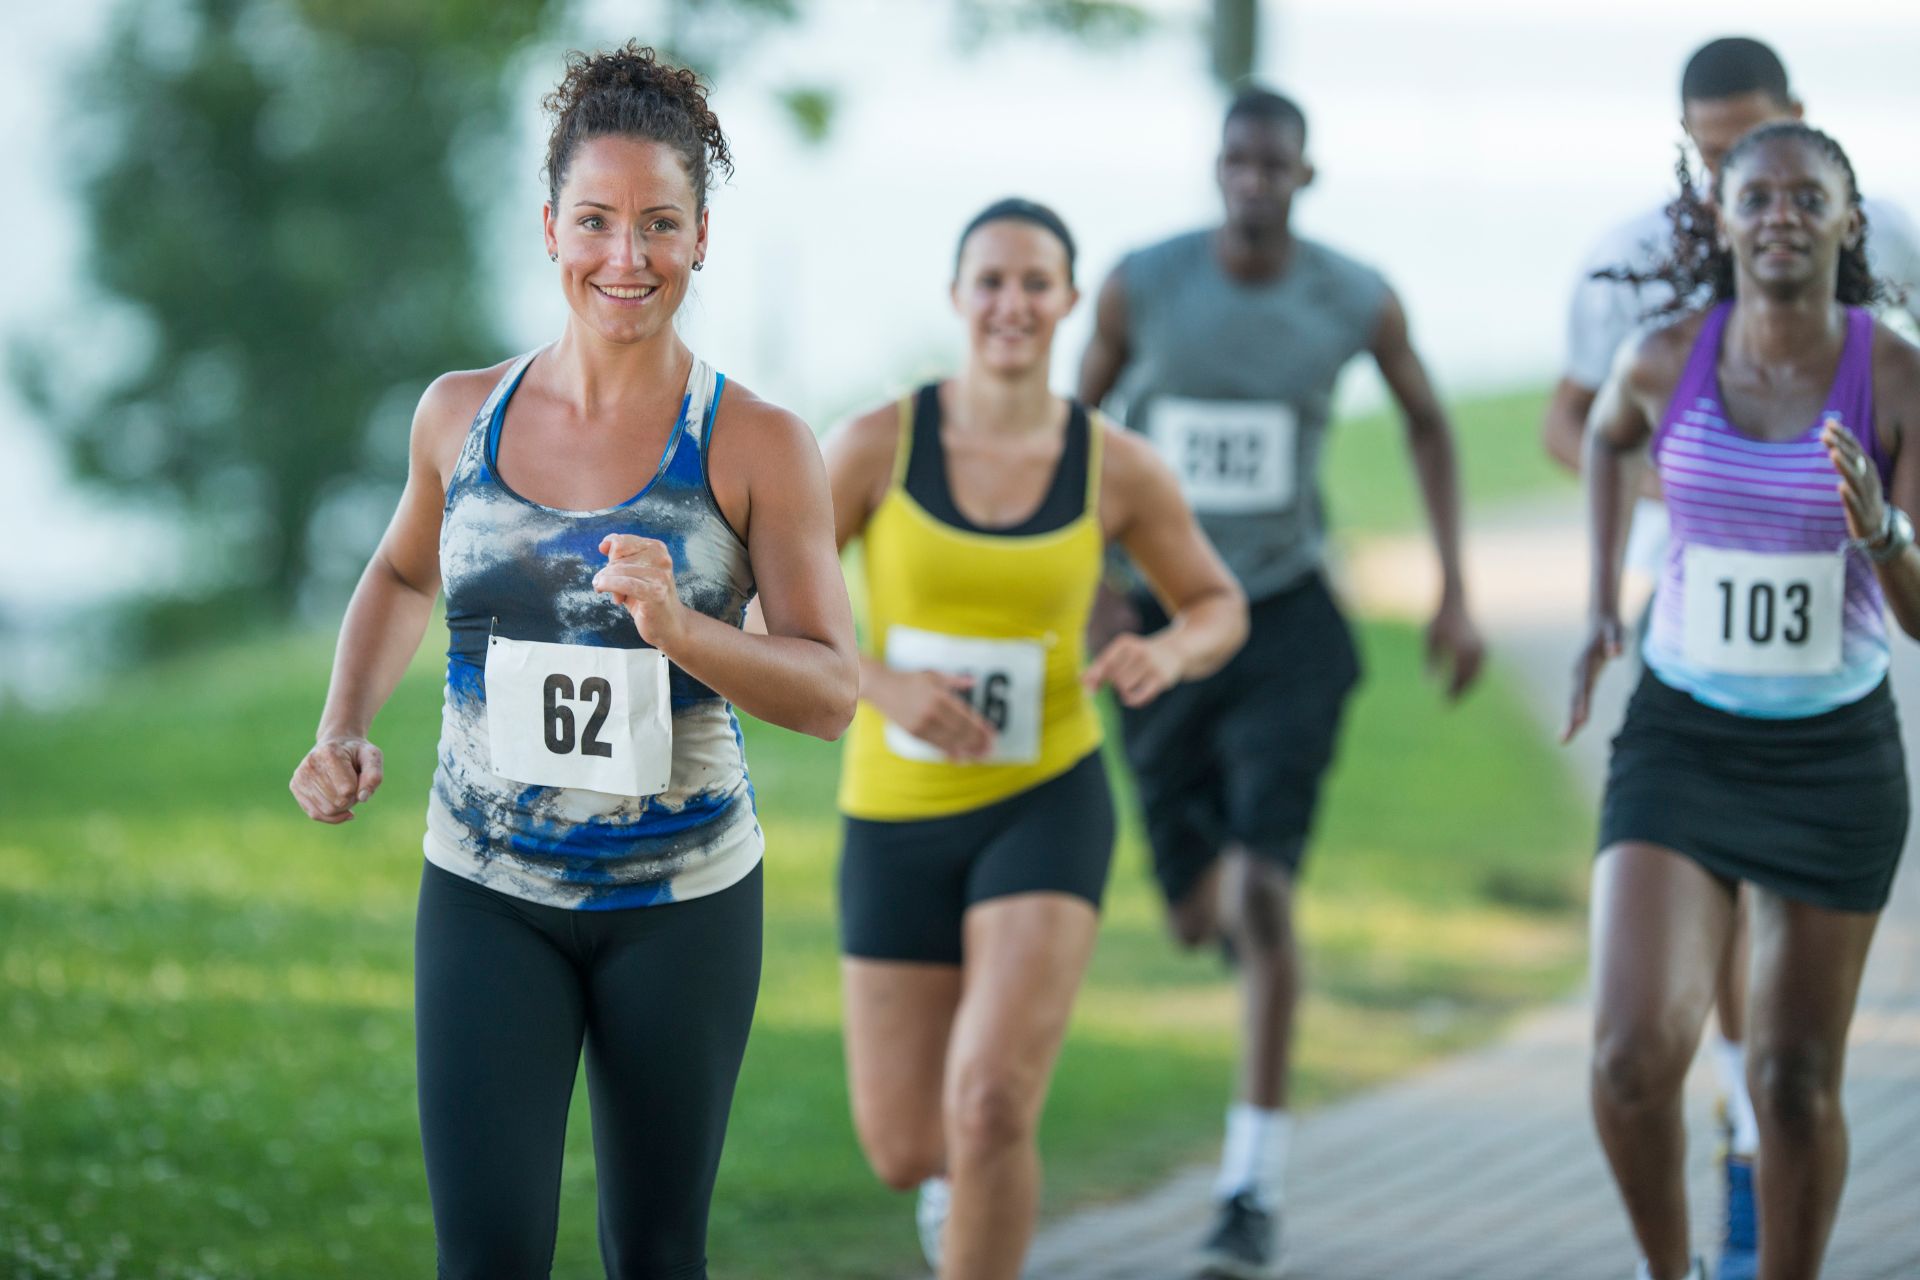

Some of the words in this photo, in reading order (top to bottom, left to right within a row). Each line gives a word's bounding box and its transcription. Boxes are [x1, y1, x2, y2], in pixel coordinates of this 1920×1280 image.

[1717, 580, 1812, 645] 103
[543, 673, 612, 758] 62
[950, 669, 1011, 736] 6
